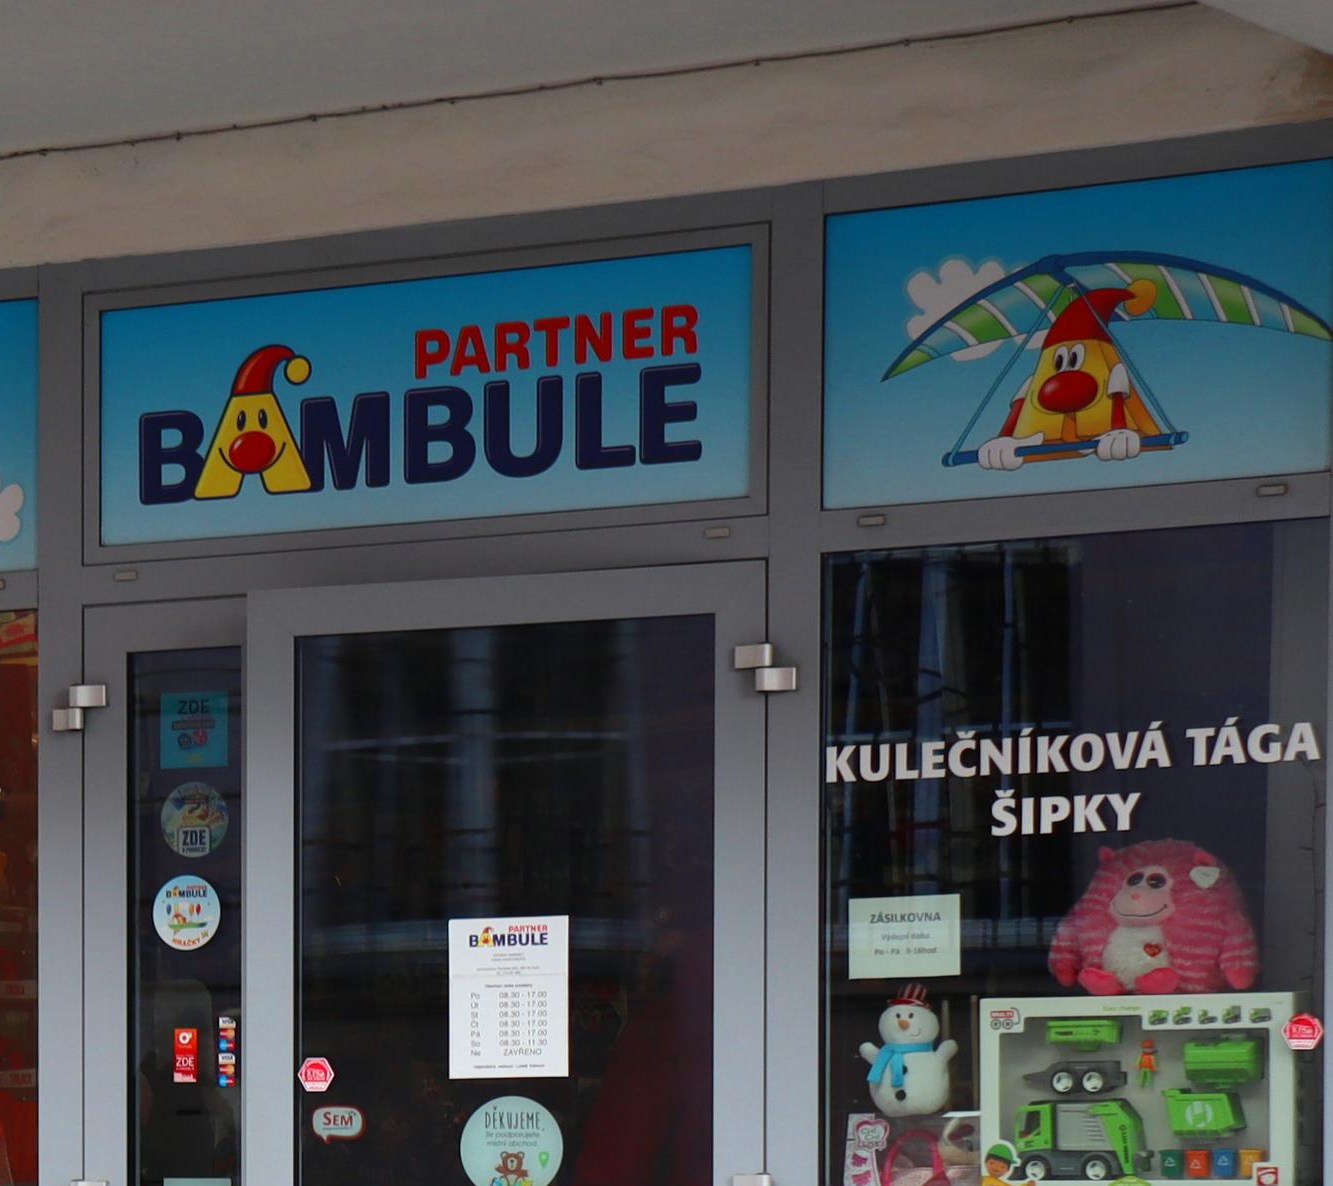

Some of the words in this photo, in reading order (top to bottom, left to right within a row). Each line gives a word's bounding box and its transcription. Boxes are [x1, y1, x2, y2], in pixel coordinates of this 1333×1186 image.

[414, 302, 701, 380] PARTNER
[139, 350, 704, 506] BAMBULE
[178, 699, 211, 715] ZDE
[825, 720, 1172, 784] KULEČNÍKOVÁ
[1185, 716, 1322, 768] TÁGA
[990, 789, 1142, 838] ŠIPKY
[182, 830, 207, 846] ZDE
[869, 911, 941, 924] ZÁSILKOVNA
[508, 925, 548, 933] PARTNER
[469, 929, 549, 947] BAMBULE
[527, 1000, 547, 1008] 17.00
[499, 1020, 520, 1028] 08.30
[503, 1048, 542, 1056] ZAVŘENO
[176, 1056, 194, 1067] ZDE
[484, 1106, 545, 1131] DĚKUJEME,
